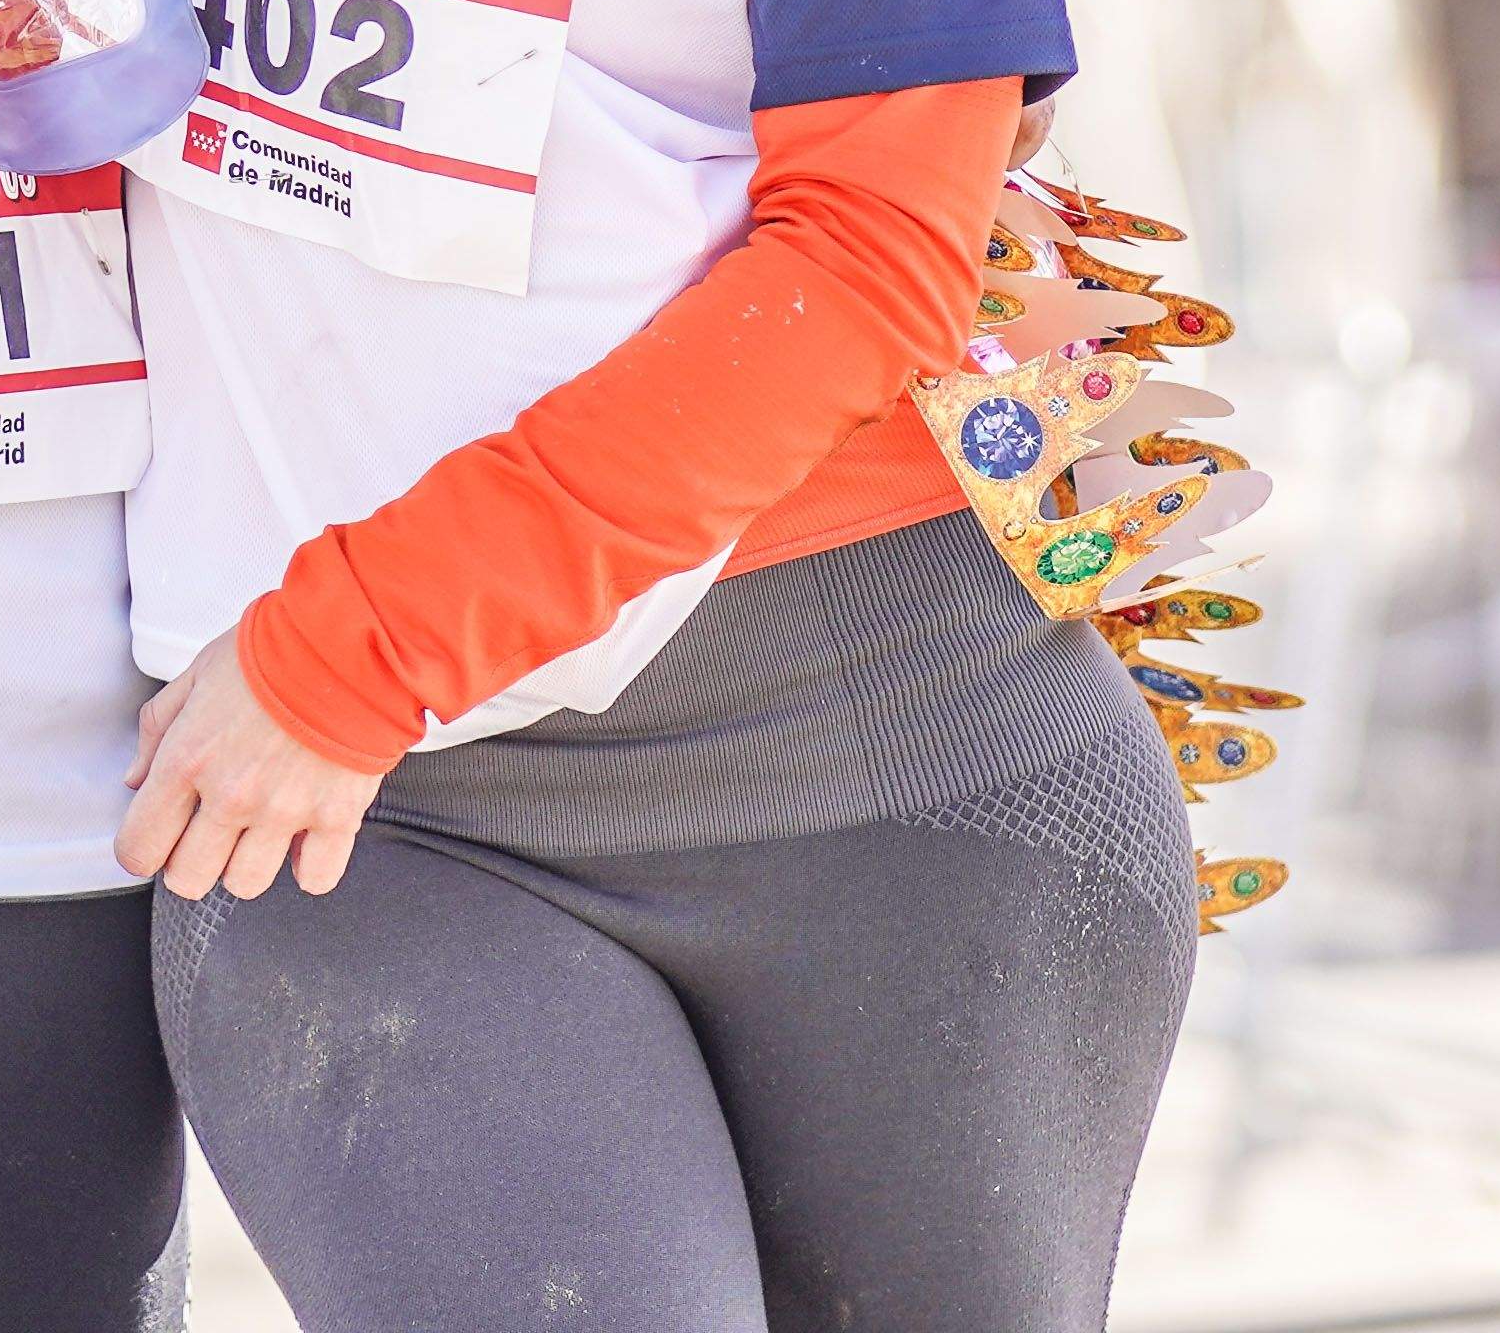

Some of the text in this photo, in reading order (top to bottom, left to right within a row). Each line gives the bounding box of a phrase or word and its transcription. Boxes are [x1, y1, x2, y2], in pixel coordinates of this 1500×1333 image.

[228, 159, 352, 219] de Madrid
[231, 129, 352, 190] Comunidad
